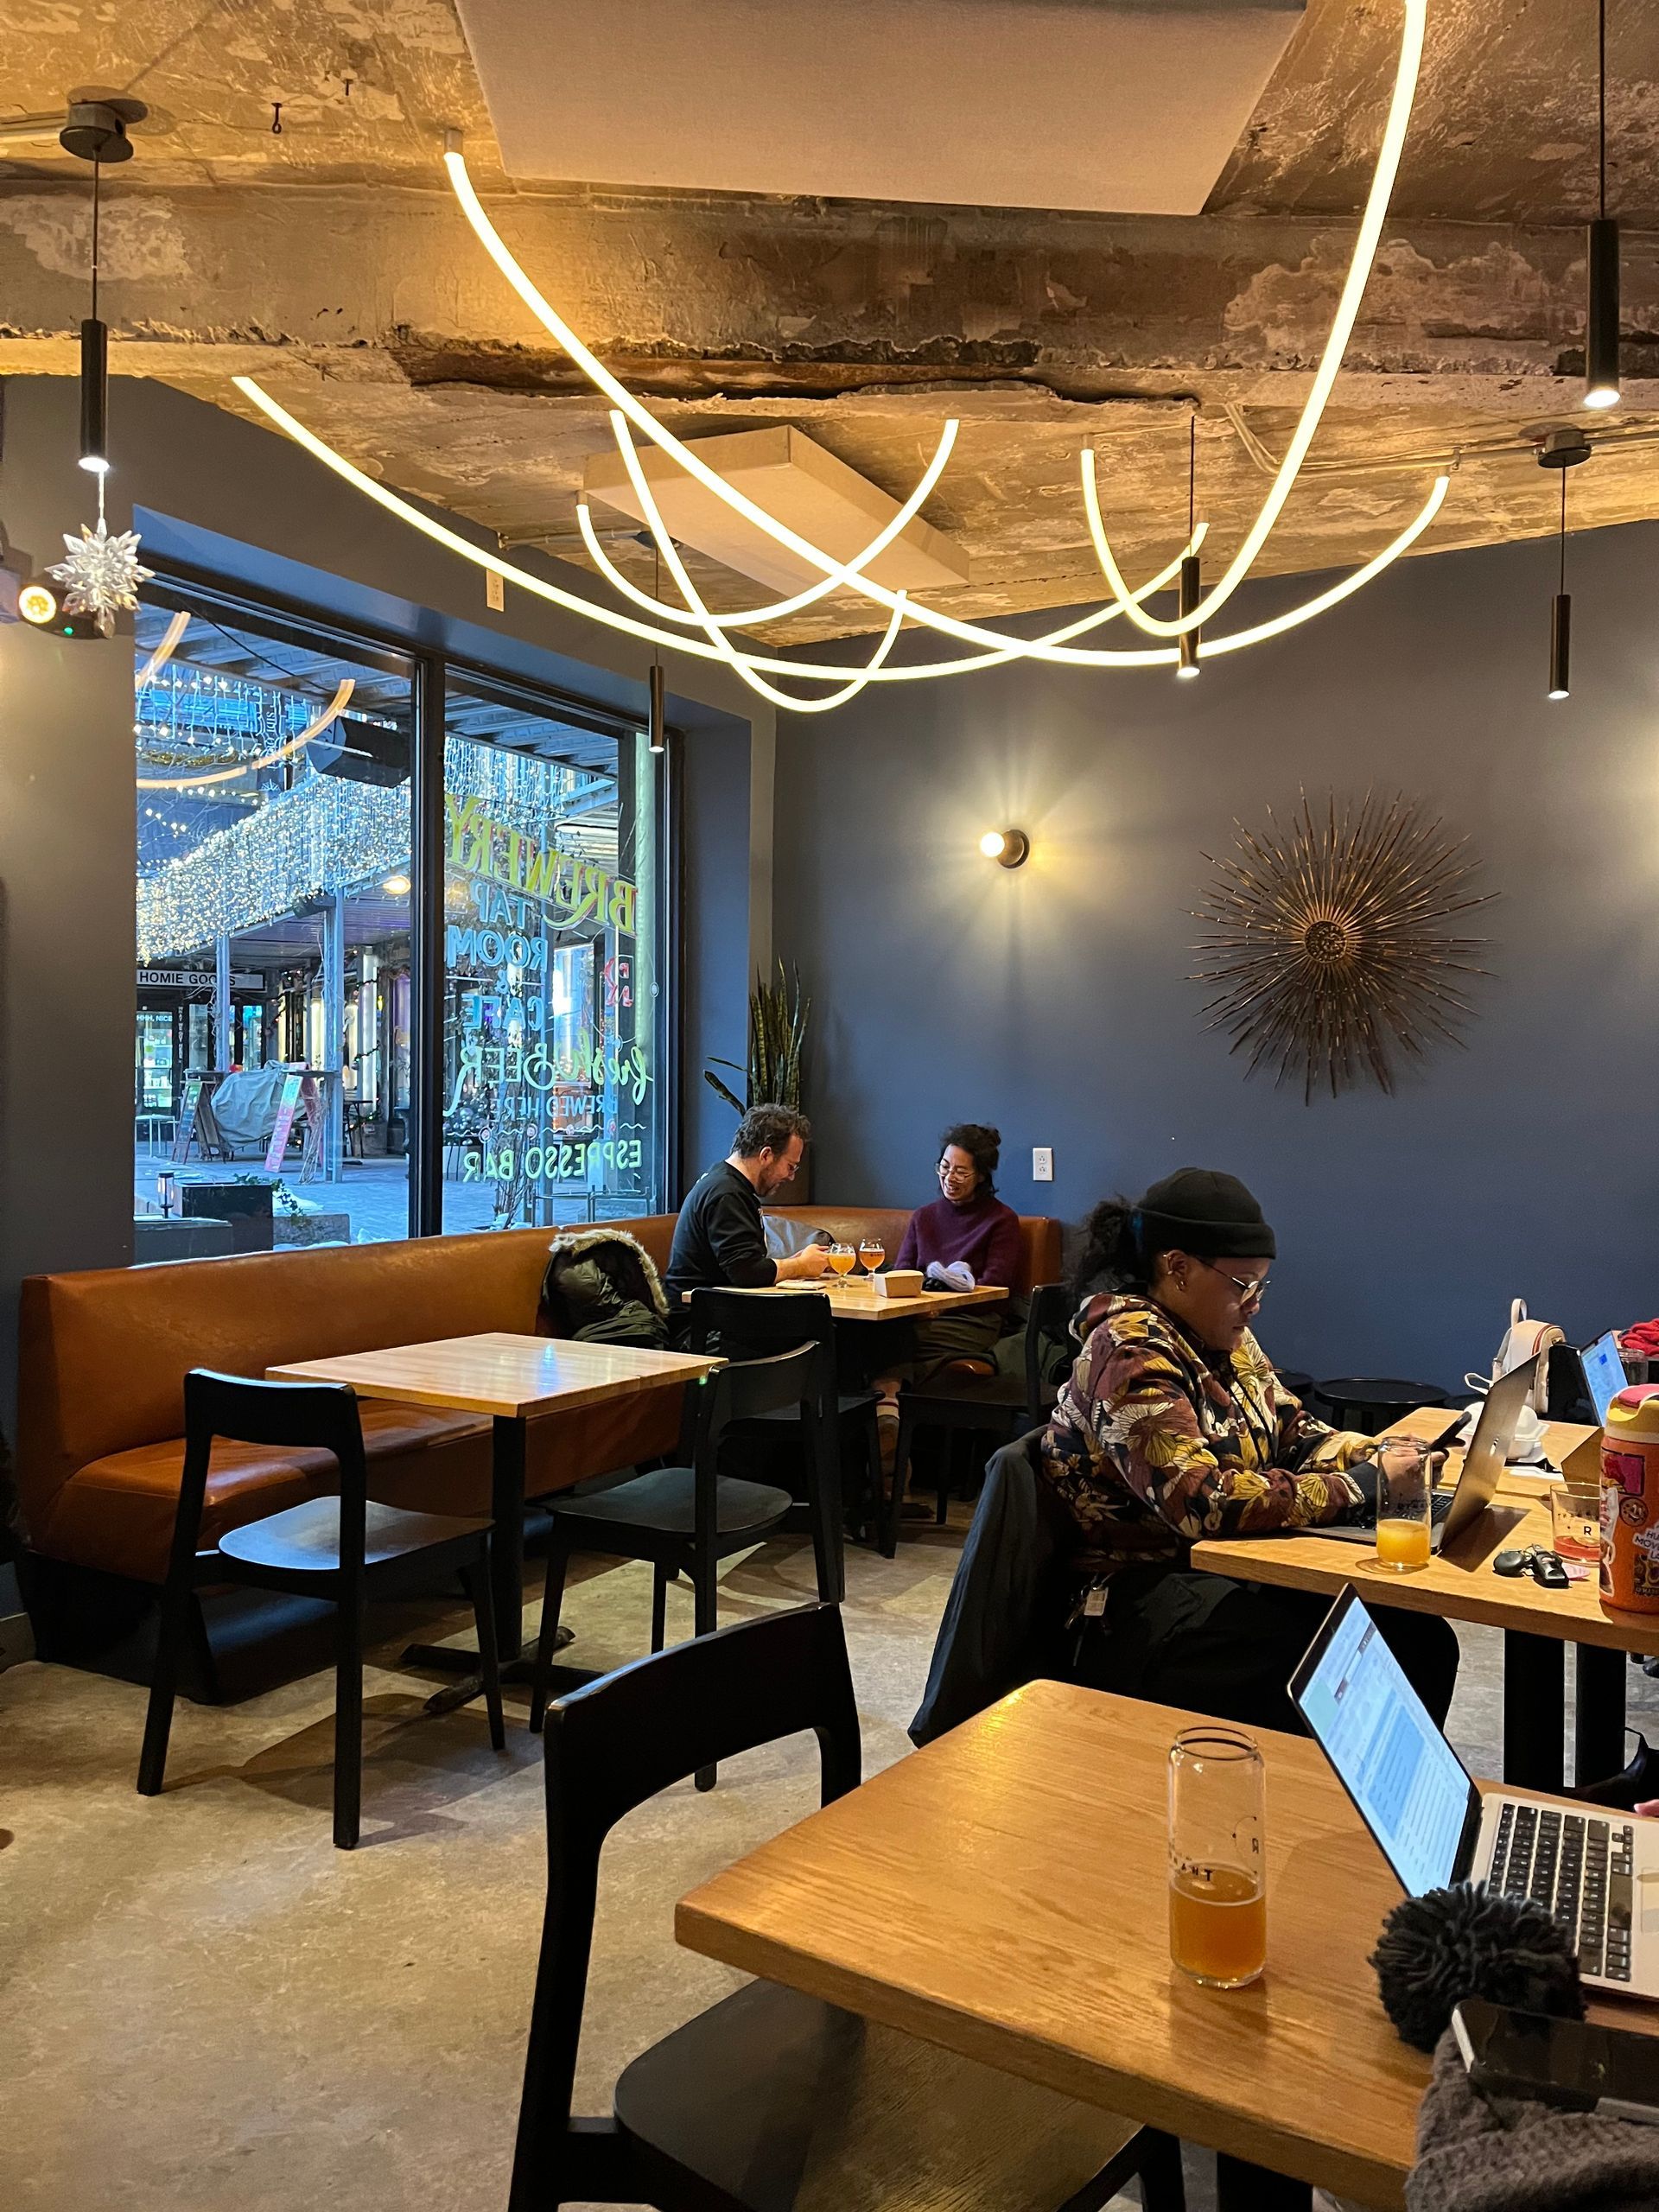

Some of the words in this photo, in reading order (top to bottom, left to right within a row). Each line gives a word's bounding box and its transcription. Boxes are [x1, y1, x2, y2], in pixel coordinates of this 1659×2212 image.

[139, 972, 183, 984] HOMIE
[188, 974, 235, 986] GOOS
[1583, 1526, 1592, 1535] R
